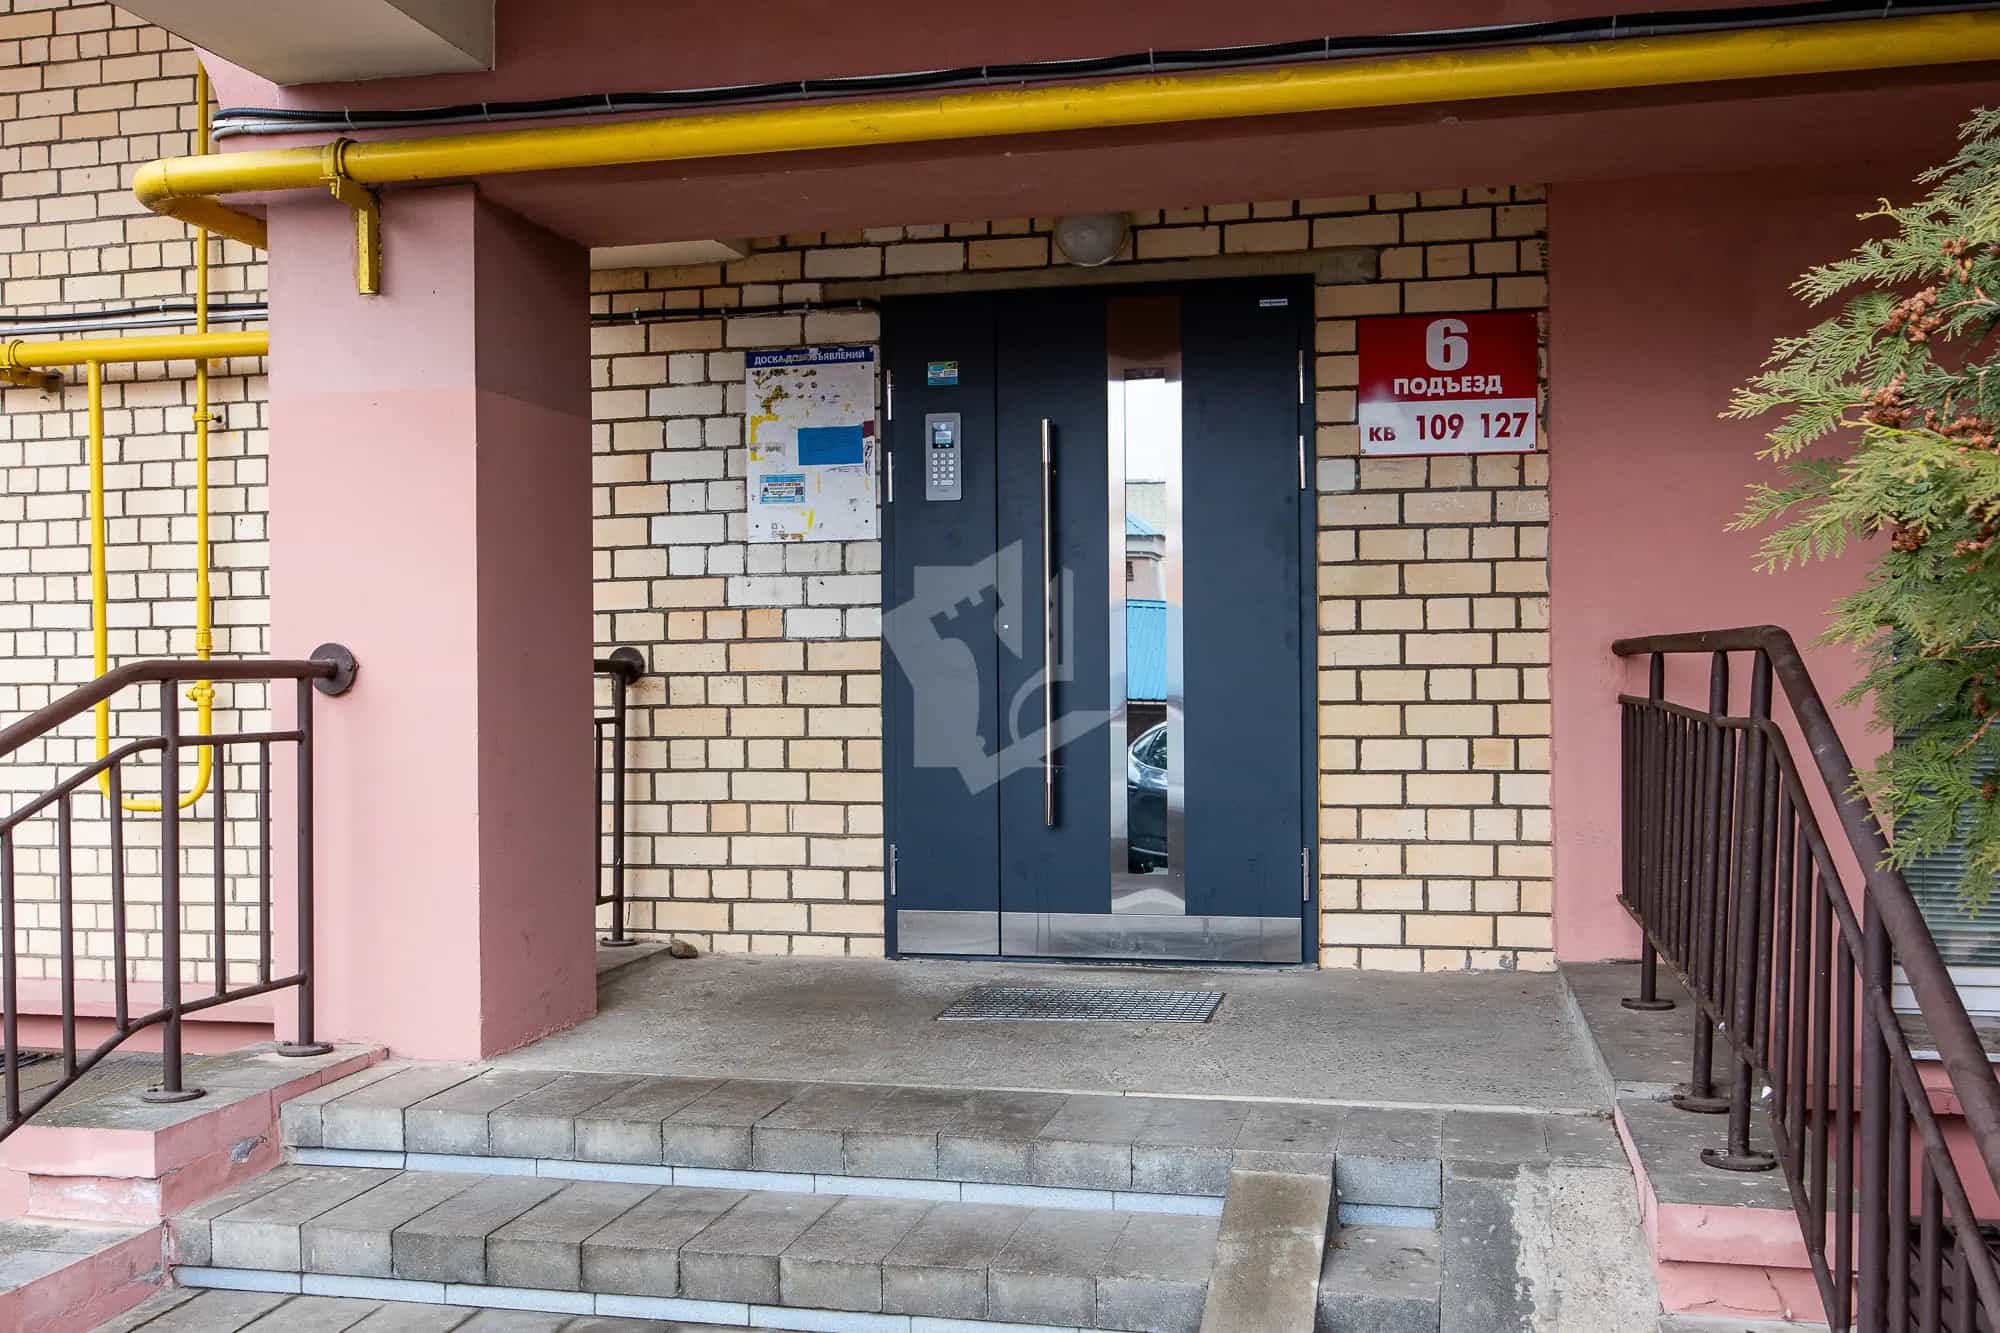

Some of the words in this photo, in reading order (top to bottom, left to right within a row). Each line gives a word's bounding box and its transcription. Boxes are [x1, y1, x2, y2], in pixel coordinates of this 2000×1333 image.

[1426, 318, 1469, 371] 6
[754, 354, 784, 366] ДОСКА
[1393, 375, 1503, 396] ПОДЪЕЗД
[1416, 413, 1464, 440] 109
[1480, 411, 1529, 438] 127
